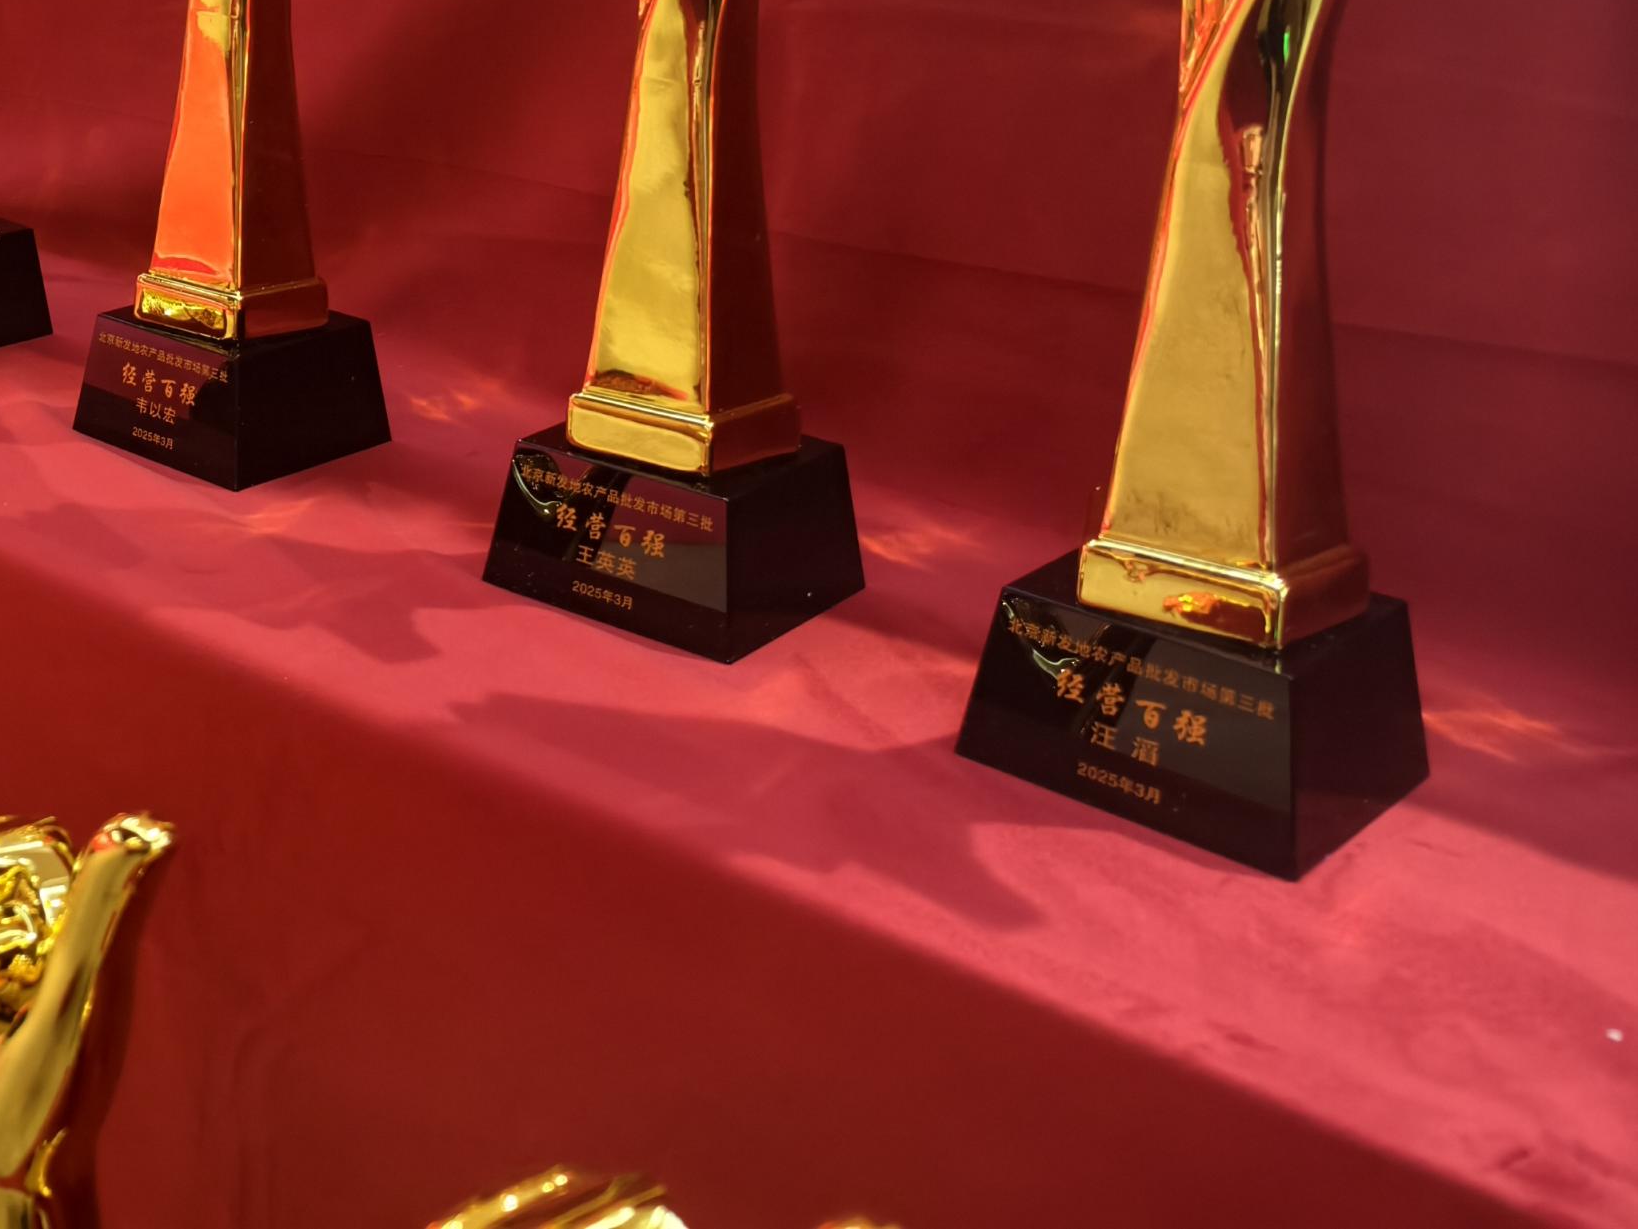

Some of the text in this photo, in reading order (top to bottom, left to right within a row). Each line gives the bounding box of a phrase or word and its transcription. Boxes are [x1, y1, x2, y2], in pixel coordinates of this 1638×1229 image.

[99, 332, 229, 384] 北京新发地农产品批发市场第三批
[122, 362, 197, 407] 经营百强
[136, 396, 177, 425] 韦以宏
[132, 426, 174, 451] 2025年3月
[521, 464, 714, 533] 北京新发地农产品批发市场第三批
[556, 502, 666, 558] 经营百强
[575, 544, 638, 580] 王英英
[571, 580, 634, 610] 2025年3月
[1007, 617, 1275, 721] 北京新发地农产品批发市场第三批
[1055, 668, 1208, 748] 经营百强
[1076, 761, 1161, 805] 2025年3月
